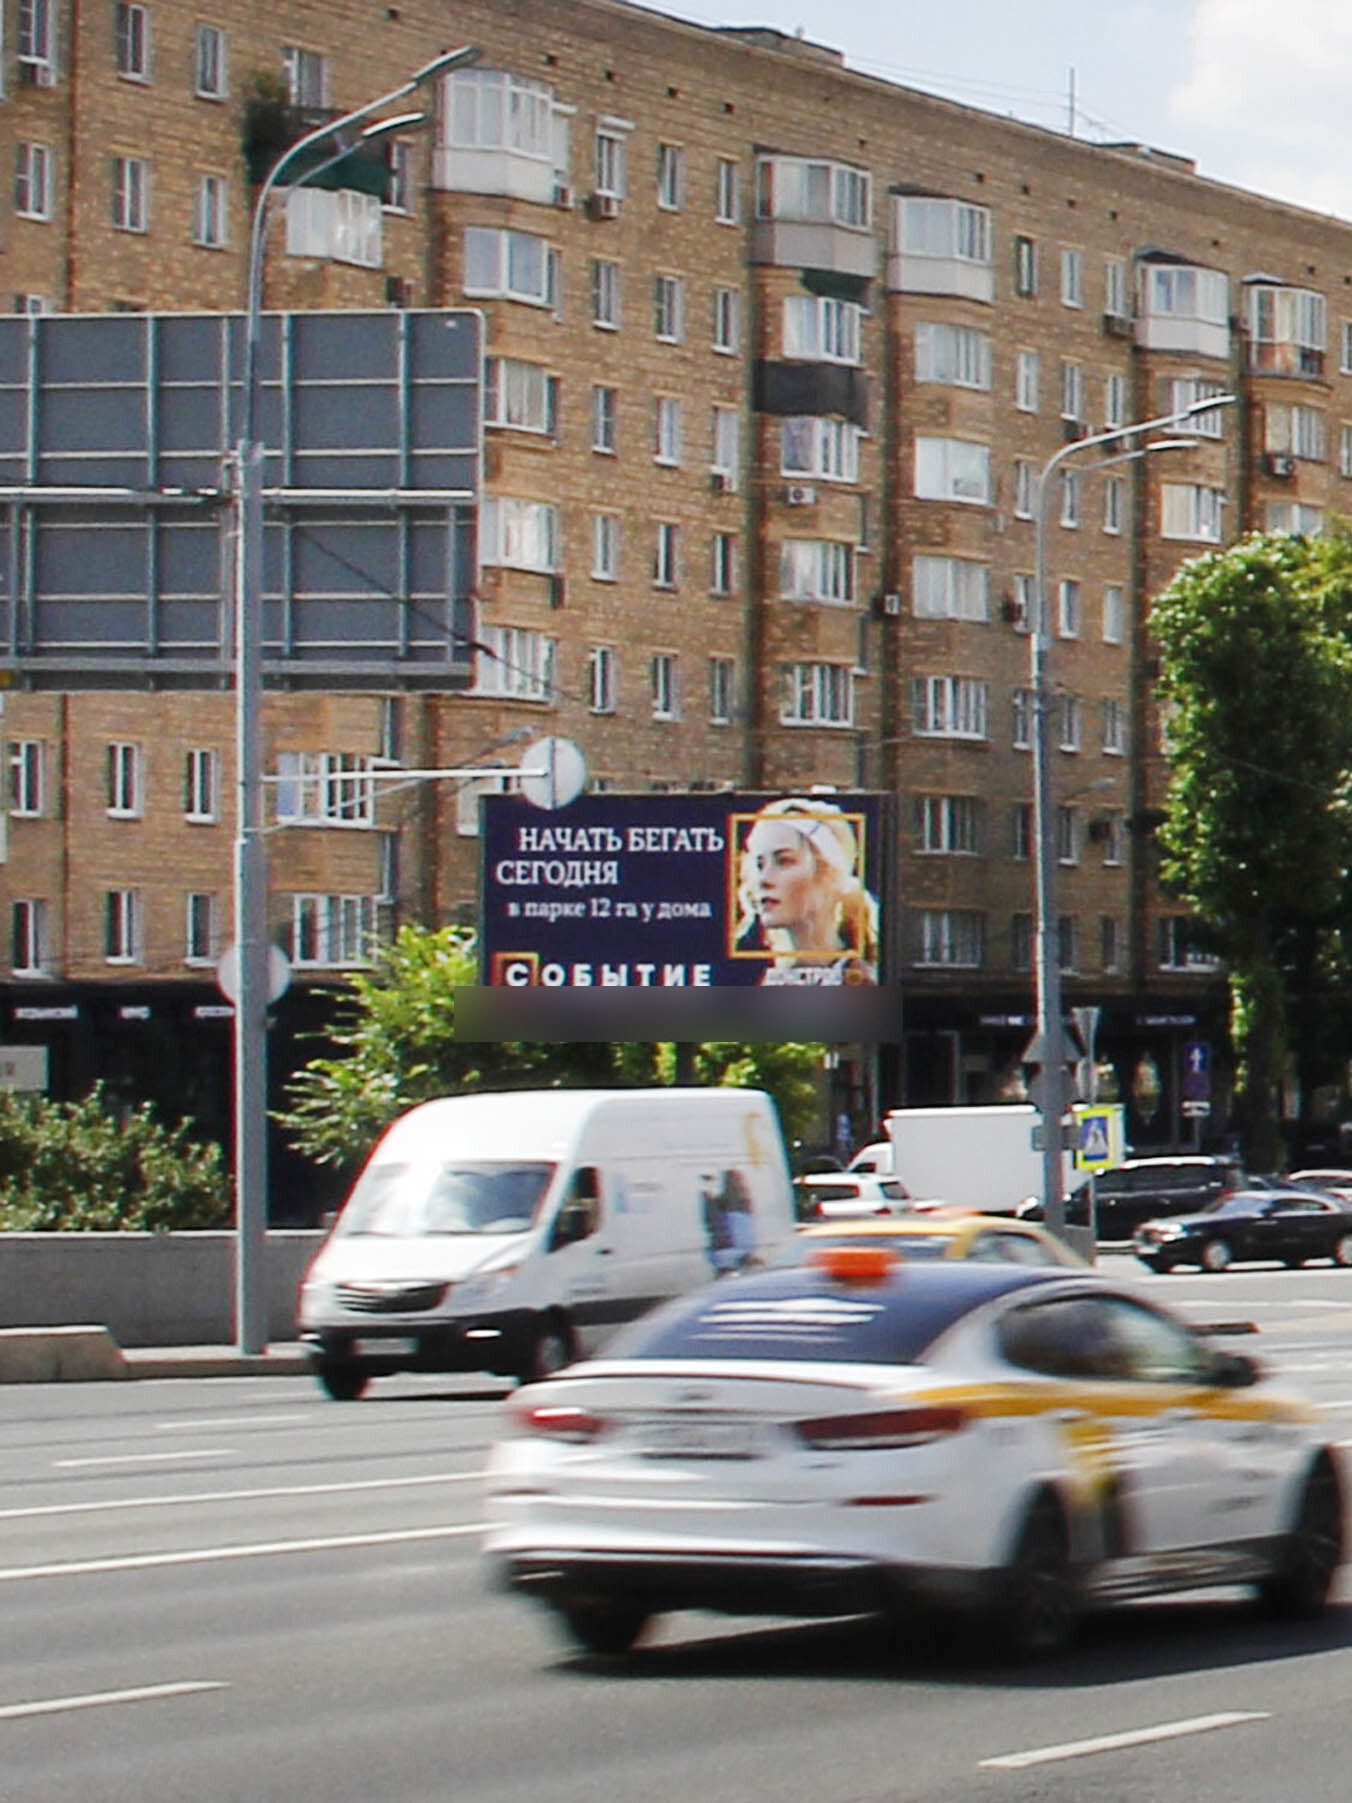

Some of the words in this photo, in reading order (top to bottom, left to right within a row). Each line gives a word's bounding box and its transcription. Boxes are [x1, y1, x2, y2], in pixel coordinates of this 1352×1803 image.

[519, 827, 622, 852] НАЧАТЬ
[628, 827, 724, 852] БЕГАТЬ
[497, 861, 618, 887] СЕГОДНЯ
[508, 902, 519, 917] в
[525, 902, 586, 923] парке
[590, 898, 611, 918] 12
[616, 903, 638, 918] га
[642, 903, 654, 923] у
[657, 902, 712, 919] дома
[506, 963, 711, 986] СОБЫТИЕ
